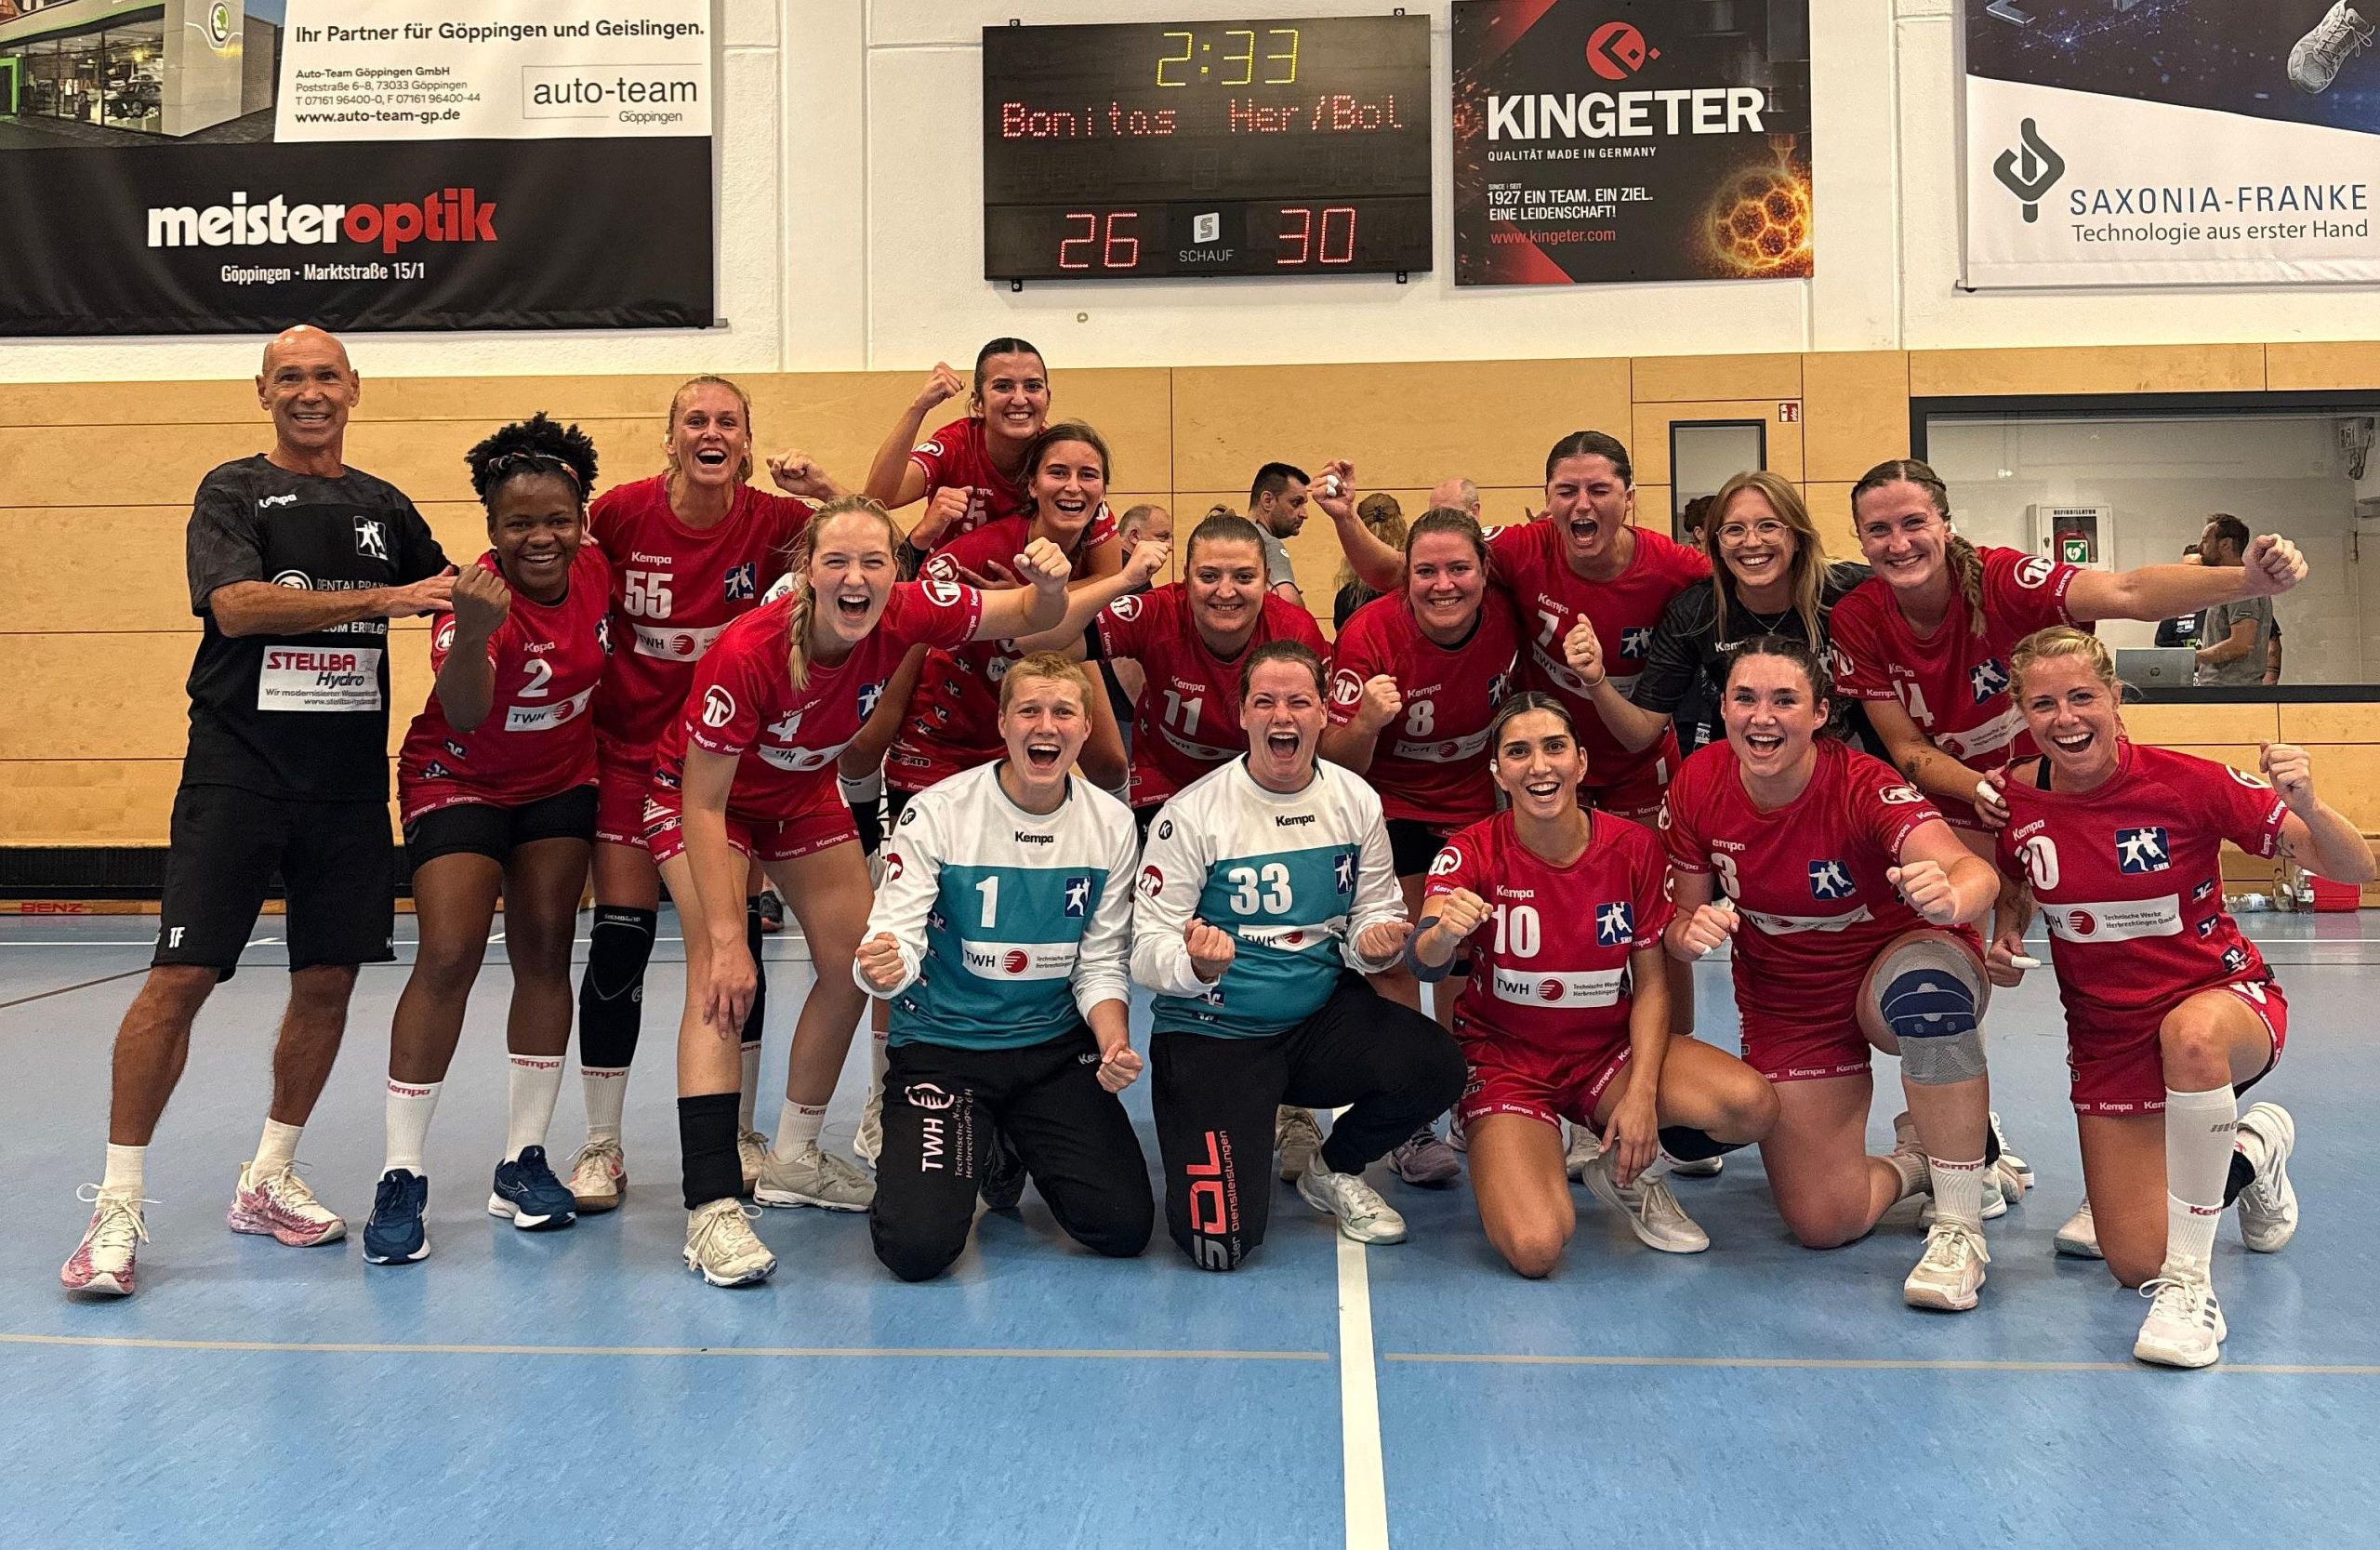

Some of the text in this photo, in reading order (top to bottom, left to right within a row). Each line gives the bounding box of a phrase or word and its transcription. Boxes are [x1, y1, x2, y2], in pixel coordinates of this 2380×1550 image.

[296, 19, 705, 43] Ihr Partner für Göppingen und Geislingen.
[1156, 29, 1299, 87] 2:33
[296, 66, 450, 79] Auto-Team Göppingen GmbH
[296, 82, 350, 93] Poststraße
[377, 81, 409, 90] 73033
[411, 80, 468, 91] Göppingen
[533, 77, 697, 105] auto-team
[296, 93, 481, 105] T 07161 96400-0, F 07161 96400-44
[295, 109, 461, 124] www.auto-team-gp.de
[618, 110, 683, 125] Göppingen
[1002, 100, 1177, 138] Bonitas
[1229, 94, 1403, 133] Her/Bol
[1488, 86, 1765, 141] KINGETER
[1488, 146, 1657, 162] QUALITÄT MADE IN GERMANY
[1487, 187, 1653, 205] 1927 EIN TEAM. EIN ZIEL.
[2069, 184, 2368, 216] SAXONIA-FRANKE
[147, 188, 498, 254] meisteroptik
[1489, 205, 1617, 220] EINE LEIDENSCHAFT!
[1059, 212, 1139, 269] 26
[1276, 206, 1356, 265] 30
[1490, 228, 1616, 245] www.kingeter.com
[2071, 219, 2368, 245] Technologie aus erster Hand
[1179, 249, 1235, 263] SCHAUF
[220, 261, 425, 285] Göppingen Marktstraße 15/1
[631, 551, 672, 566] Kempa
[624, 569, 673, 620] 55
[1537, 592, 1569, 615] Kempa
[1537, 609, 1560, 648] 7
[266, 652, 357, 671] STELLBA
[316, 672, 364, 689] Hydro
[517, 658, 552, 698] 2
[1171, 675, 1206, 694] Kempa
[266, 688, 280, 696] Wir
[1407, 683, 1442, 699] Kempa
[1163, 689, 1203, 736] 11
[1405, 699, 1435, 736] 8
[767, 712, 803, 742] 4
[1276, 814, 1316, 828] Kempa
[2012, 819, 2045, 841] Kempa
[774, 847, 807, 858] Kempa
[815, 833, 849, 847] Kempa
[1014, 831, 1054, 846] Kempa
[1712, 838, 1746, 852] empa
[1890, 824, 1911, 854] Kempa
[1668, 853, 1699, 870] Kempa
[1227, 862, 1293, 916] 33
[1496, 884, 1535, 900] Kempa
[20, 902, 83, 913] BENZ
[975, 876, 998, 929] 1
[2104, 913, 2139, 921] Technische
[1491, 903, 1540, 959] 10
[965, 949, 996, 968] TWH
[1496, 977, 1529, 995] TWH
[581, 1070, 626, 1080] empa
[1789, 1067, 1826, 1078] Kempa
[1836, 1063, 1865, 1073] Kempa
[1590, 1066, 1615, 1097] Kempa
[1466, 1103, 1534, 1118] Kempa Kempa
[2099, 1102, 2134, 1113] Kempa
[921, 1118, 944, 1172] TWH
